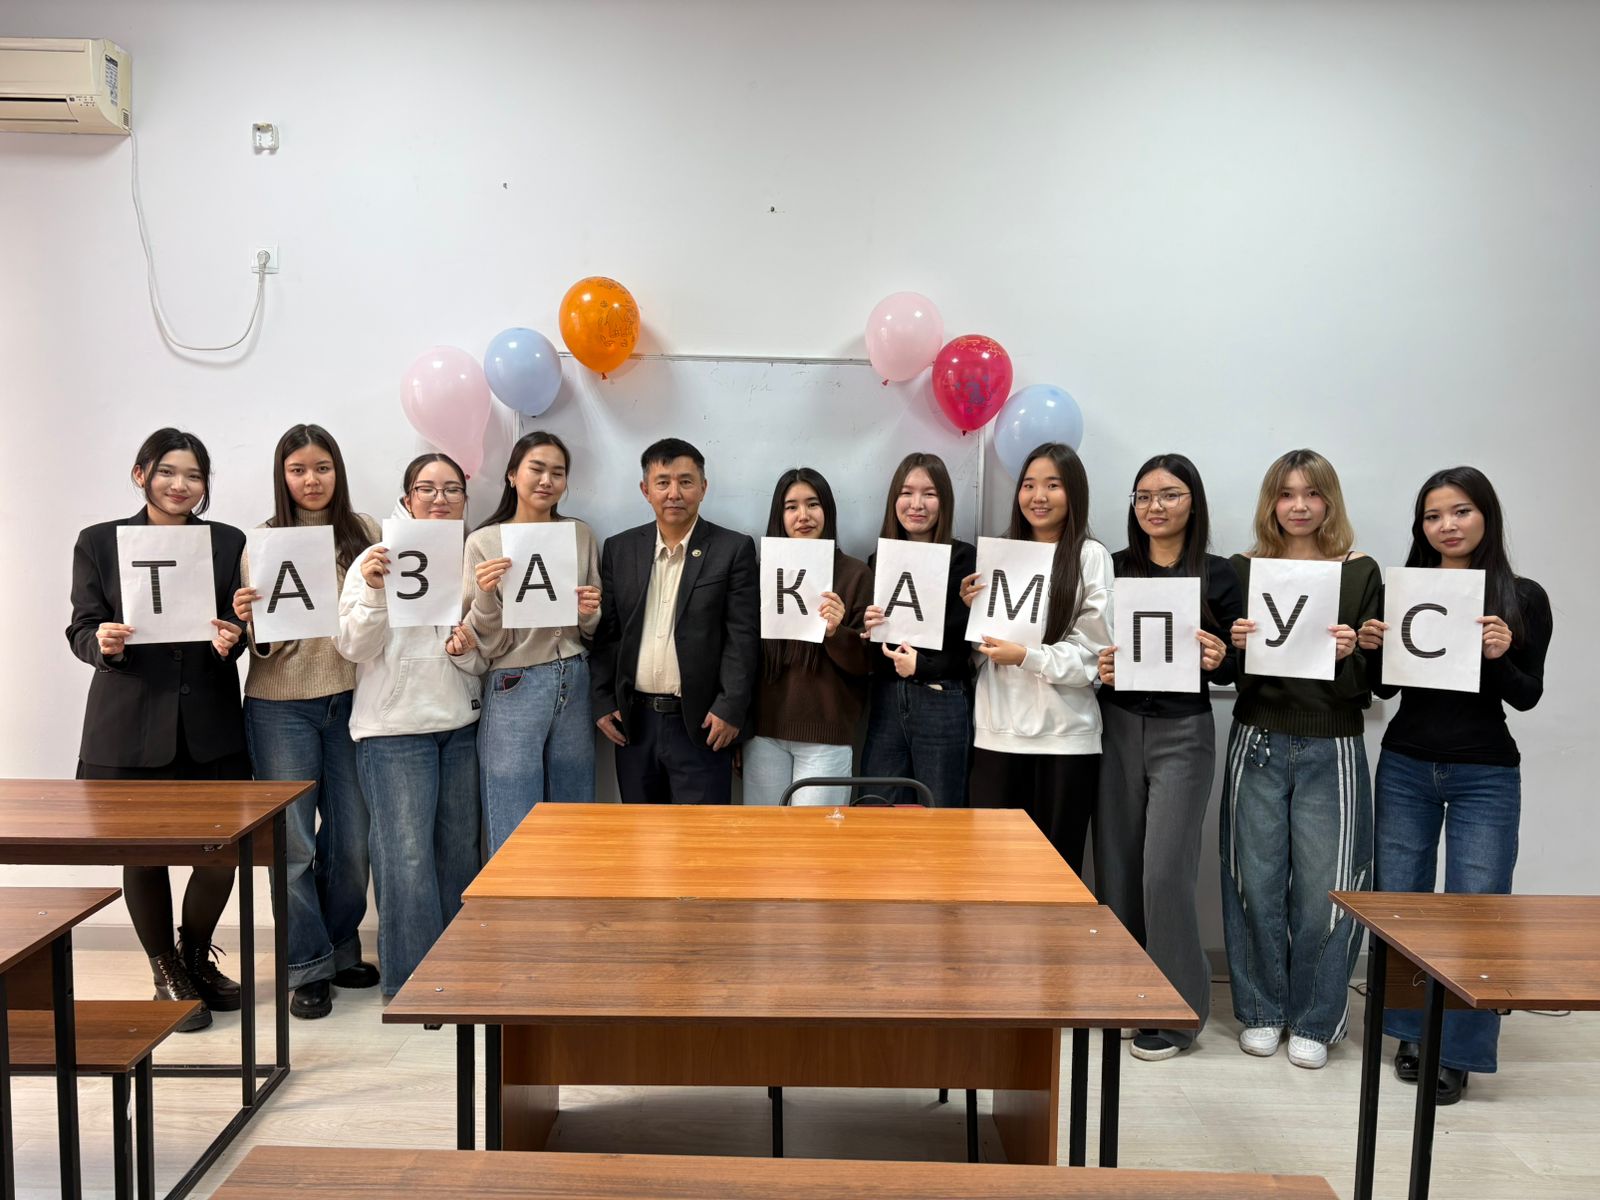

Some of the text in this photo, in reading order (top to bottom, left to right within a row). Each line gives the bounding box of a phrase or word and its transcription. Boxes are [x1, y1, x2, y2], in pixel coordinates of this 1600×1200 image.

[131, 560, 177, 615] Т
[266, 560, 316, 614] А
[396, 550, 429, 600] З
[515, 553, 558, 603] А
[776, 568, 809, 616] К
[884, 571, 925, 622] А
[987, 569, 1045, 624] М
[1133, 611, 1174, 663] П
[1262, 592, 1310, 648] У
[1401, 603, 1449, 659] С
